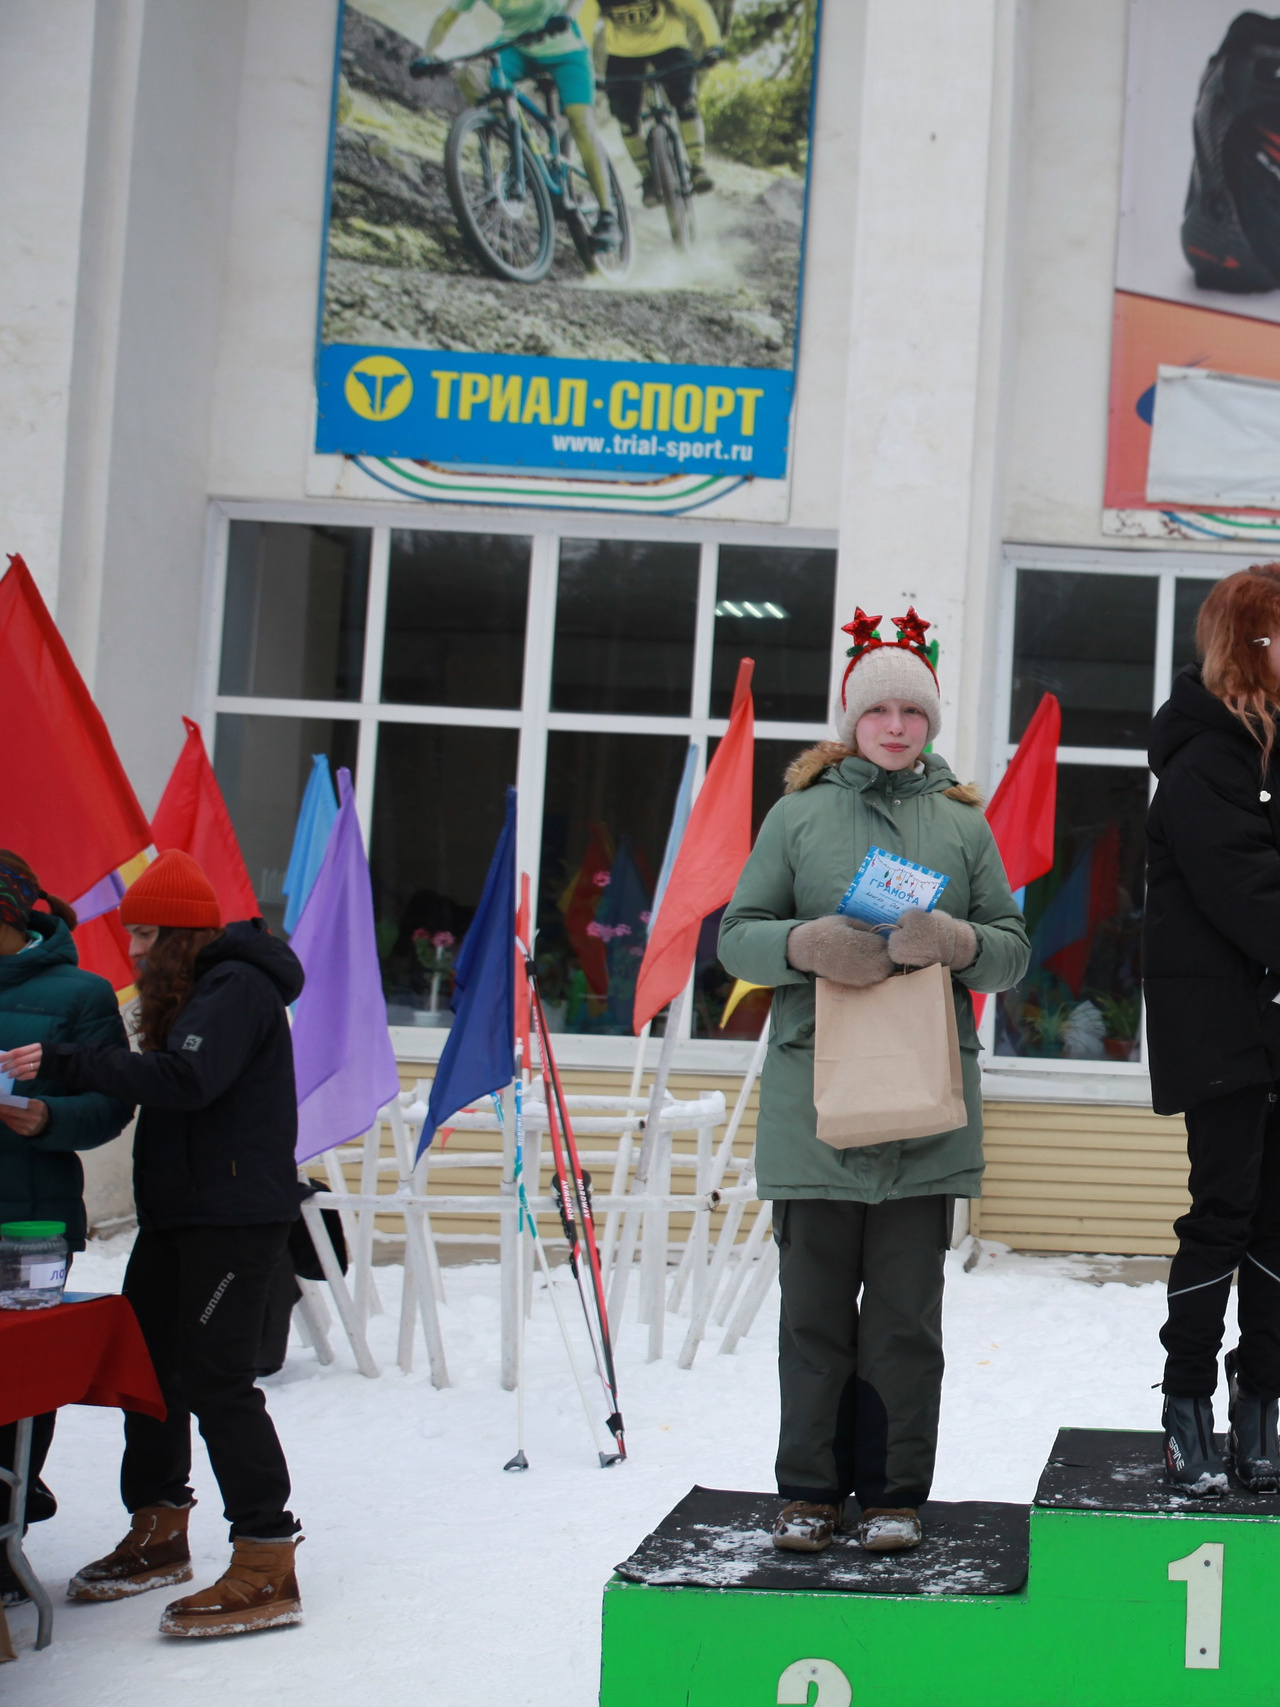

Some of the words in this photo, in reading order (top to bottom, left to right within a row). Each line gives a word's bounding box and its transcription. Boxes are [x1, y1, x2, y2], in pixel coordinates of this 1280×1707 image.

[552, 432, 754, 463] www.trial-sport.ru
[869, 878, 920, 906] ГРАМОТА
[561, 1179, 575, 1220] NORDWAY
[576, 1178, 591, 1218] NORDWAY
[200, 1271, 235, 1325] noname
[1169, 1435, 1185, 1472] SPINE
[1167, 1542, 1225, 1670] 1
